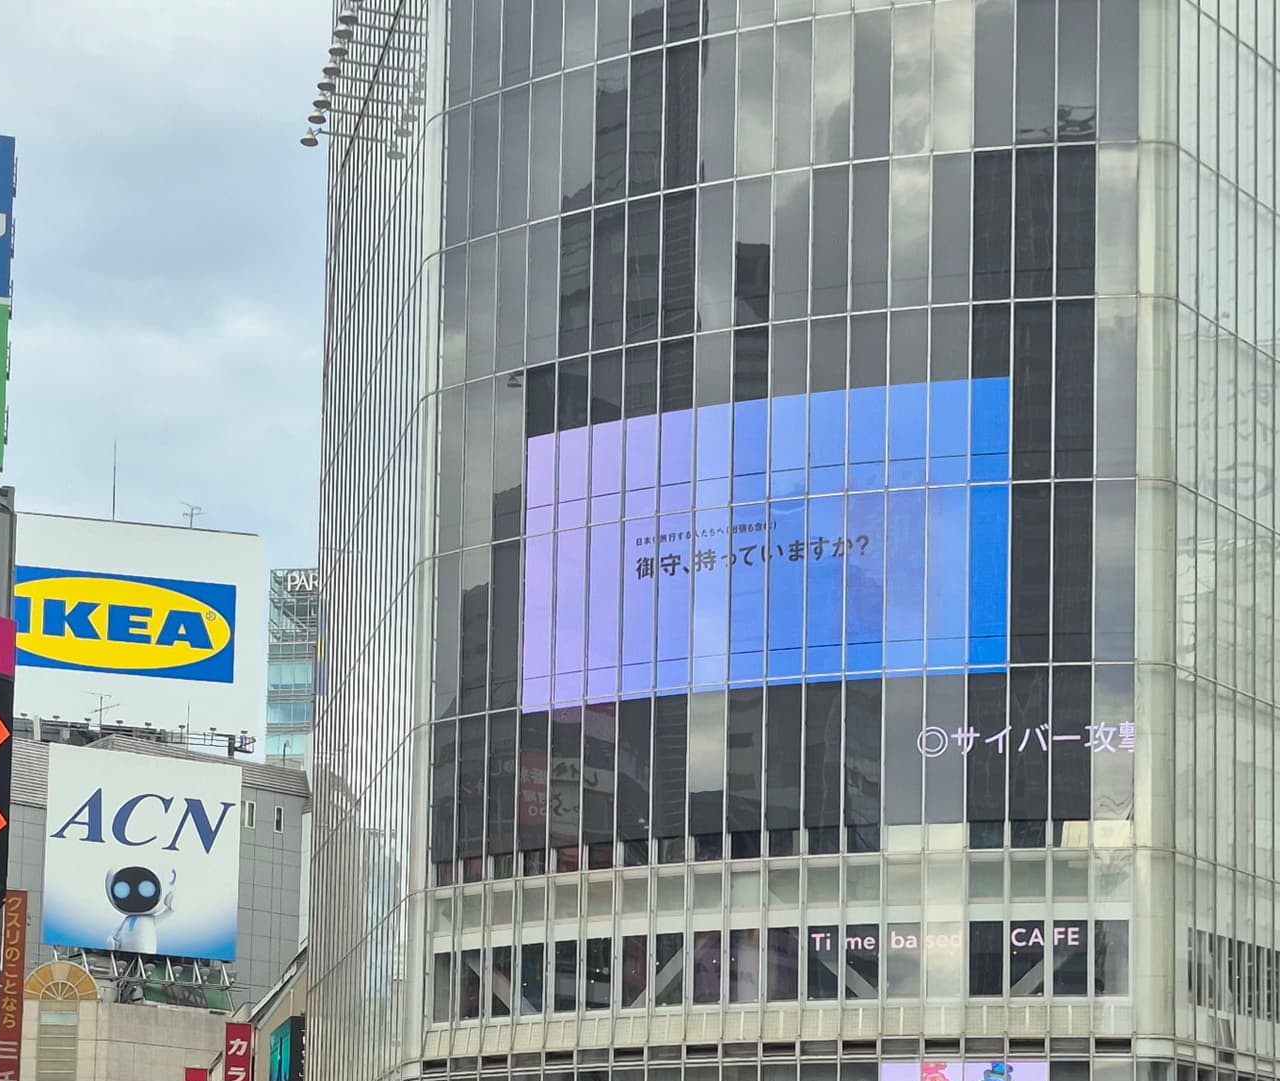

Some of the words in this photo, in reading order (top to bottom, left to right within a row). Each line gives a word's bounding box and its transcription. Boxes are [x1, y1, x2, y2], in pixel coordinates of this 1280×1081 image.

[287, 571, 318, 591] PAR
[15, 594, 215, 650] IKEA
[50, 787, 236, 855] ACN
[811, 932, 876, 951] Time
[1011, 928, 1080, 947] CAFE
